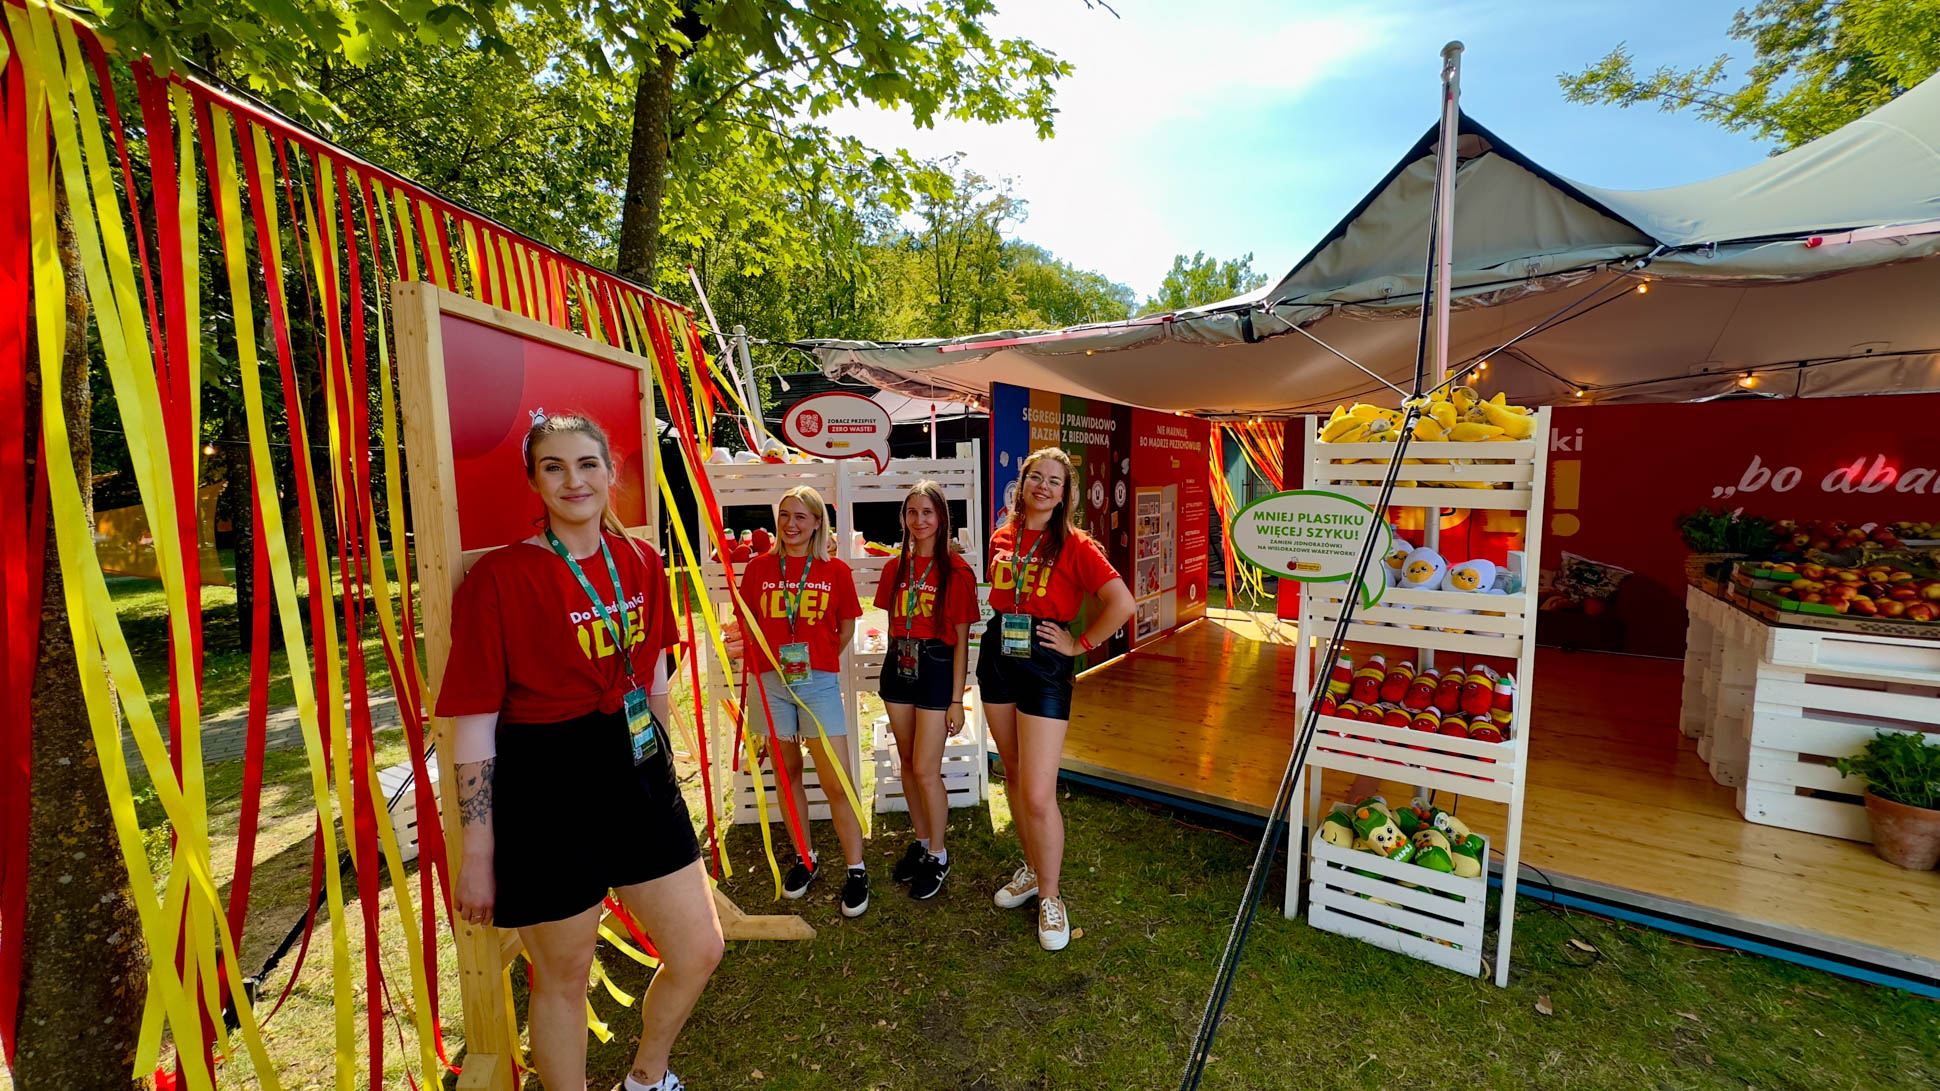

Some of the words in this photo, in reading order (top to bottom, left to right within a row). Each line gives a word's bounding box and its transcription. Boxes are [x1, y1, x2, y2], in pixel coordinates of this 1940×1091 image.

[1022, 407, 1065, 425] SEGREGUJ
[1066, 413, 1116, 431] PRAWIDŁOWO
[1031, 427, 1060, 441] RAZEM
[1062, 430, 1067, 442] Z
[1069, 430, 1109, 448] BIEDRONKĄ
[1139, 436, 1148, 446] BO
[1253, 511, 1294, 523] MNIEJ
[1298, 512, 1364, 526] PLASTIKU
[1256, 525, 1302, 538] WIĘCEJ
[1307, 527, 1359, 541] SZYKU!
[762, 581, 776, 590] Do
[570, 611, 591, 624] Do
[591, 591, 645, 618] Bedonki
[760, 589, 829, 626] IDĘ!
